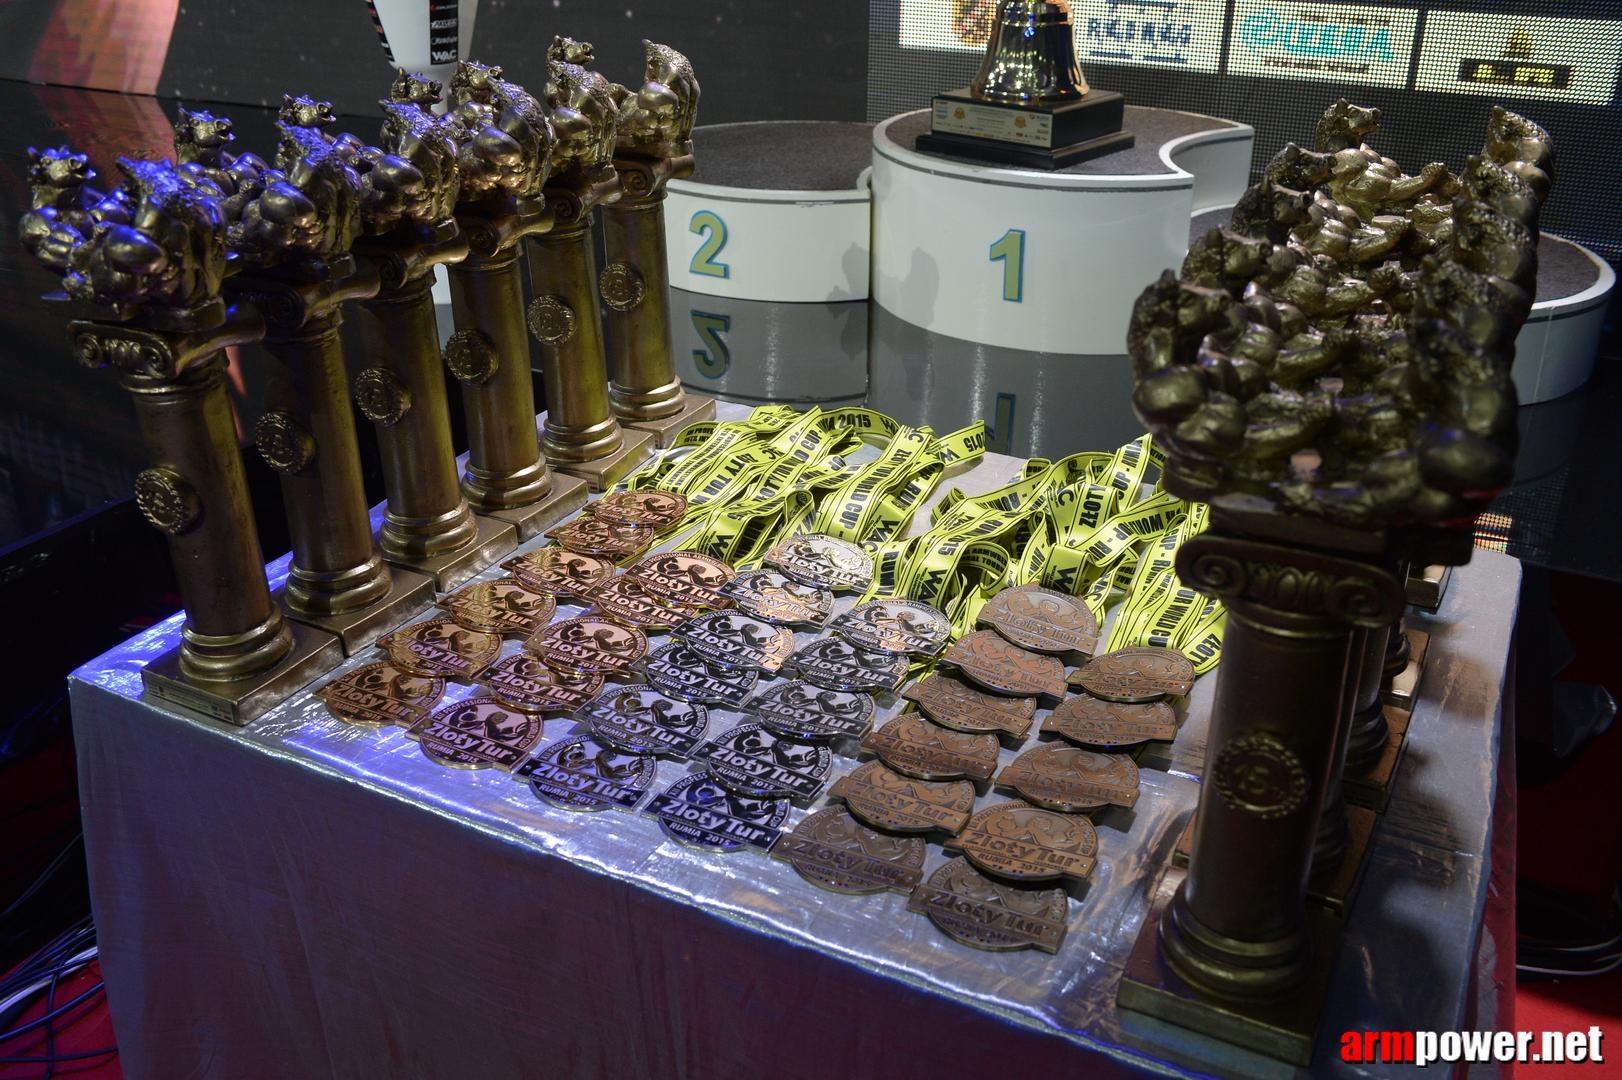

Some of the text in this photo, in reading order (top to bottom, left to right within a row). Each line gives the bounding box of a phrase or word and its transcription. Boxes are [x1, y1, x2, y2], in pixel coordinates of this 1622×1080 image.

[688, 209, 730, 280] 2
[989, 227, 1026, 303] 1
[838, 413, 872, 429] 2015
[962, 432, 986, 453] 015
[703, 473, 733, 496] TUR
[839, 504, 863, 530] CUP
[645, 582, 672, 597] RUMIA
[688, 584, 721, 602] Tur
[1173, 589, 1198, 606] UR
[605, 604, 632, 618] RUMIA
[650, 605, 684, 624] Tur
[1148, 629, 1172, 648] CU
[546, 651, 575, 665] RUMIA
[593, 650, 632, 670] Tur
[692, 642, 722, 659] RUMIA
[723, 653, 745, 666] 2015
[740, 646, 776, 667] Tur
[855, 666, 892, 684] Tur
[497, 686, 527, 700] RUMIA
[546, 683, 583, 703] Tur
[653, 674, 709, 700] RUMIA 2015
[703, 676, 739, 698] Tur
[599, 722, 628, 739] RUMIA
[817, 714, 857, 731] Tur
[646, 725, 687, 747] Tur
[427, 741, 481, 764] RUMIA 2015
[476, 737, 514, 759] Tur
[716, 766, 777, 791] RUMIA 2015
[769, 765, 810, 788] Tur
[538, 783, 599, 806] RUMIA 2015
[591, 778, 633, 801] Tur
[668, 821, 733, 847] RUMIA 2015
[724, 817, 767, 841] Tur
[1036, 847, 1081, 867] Tur
